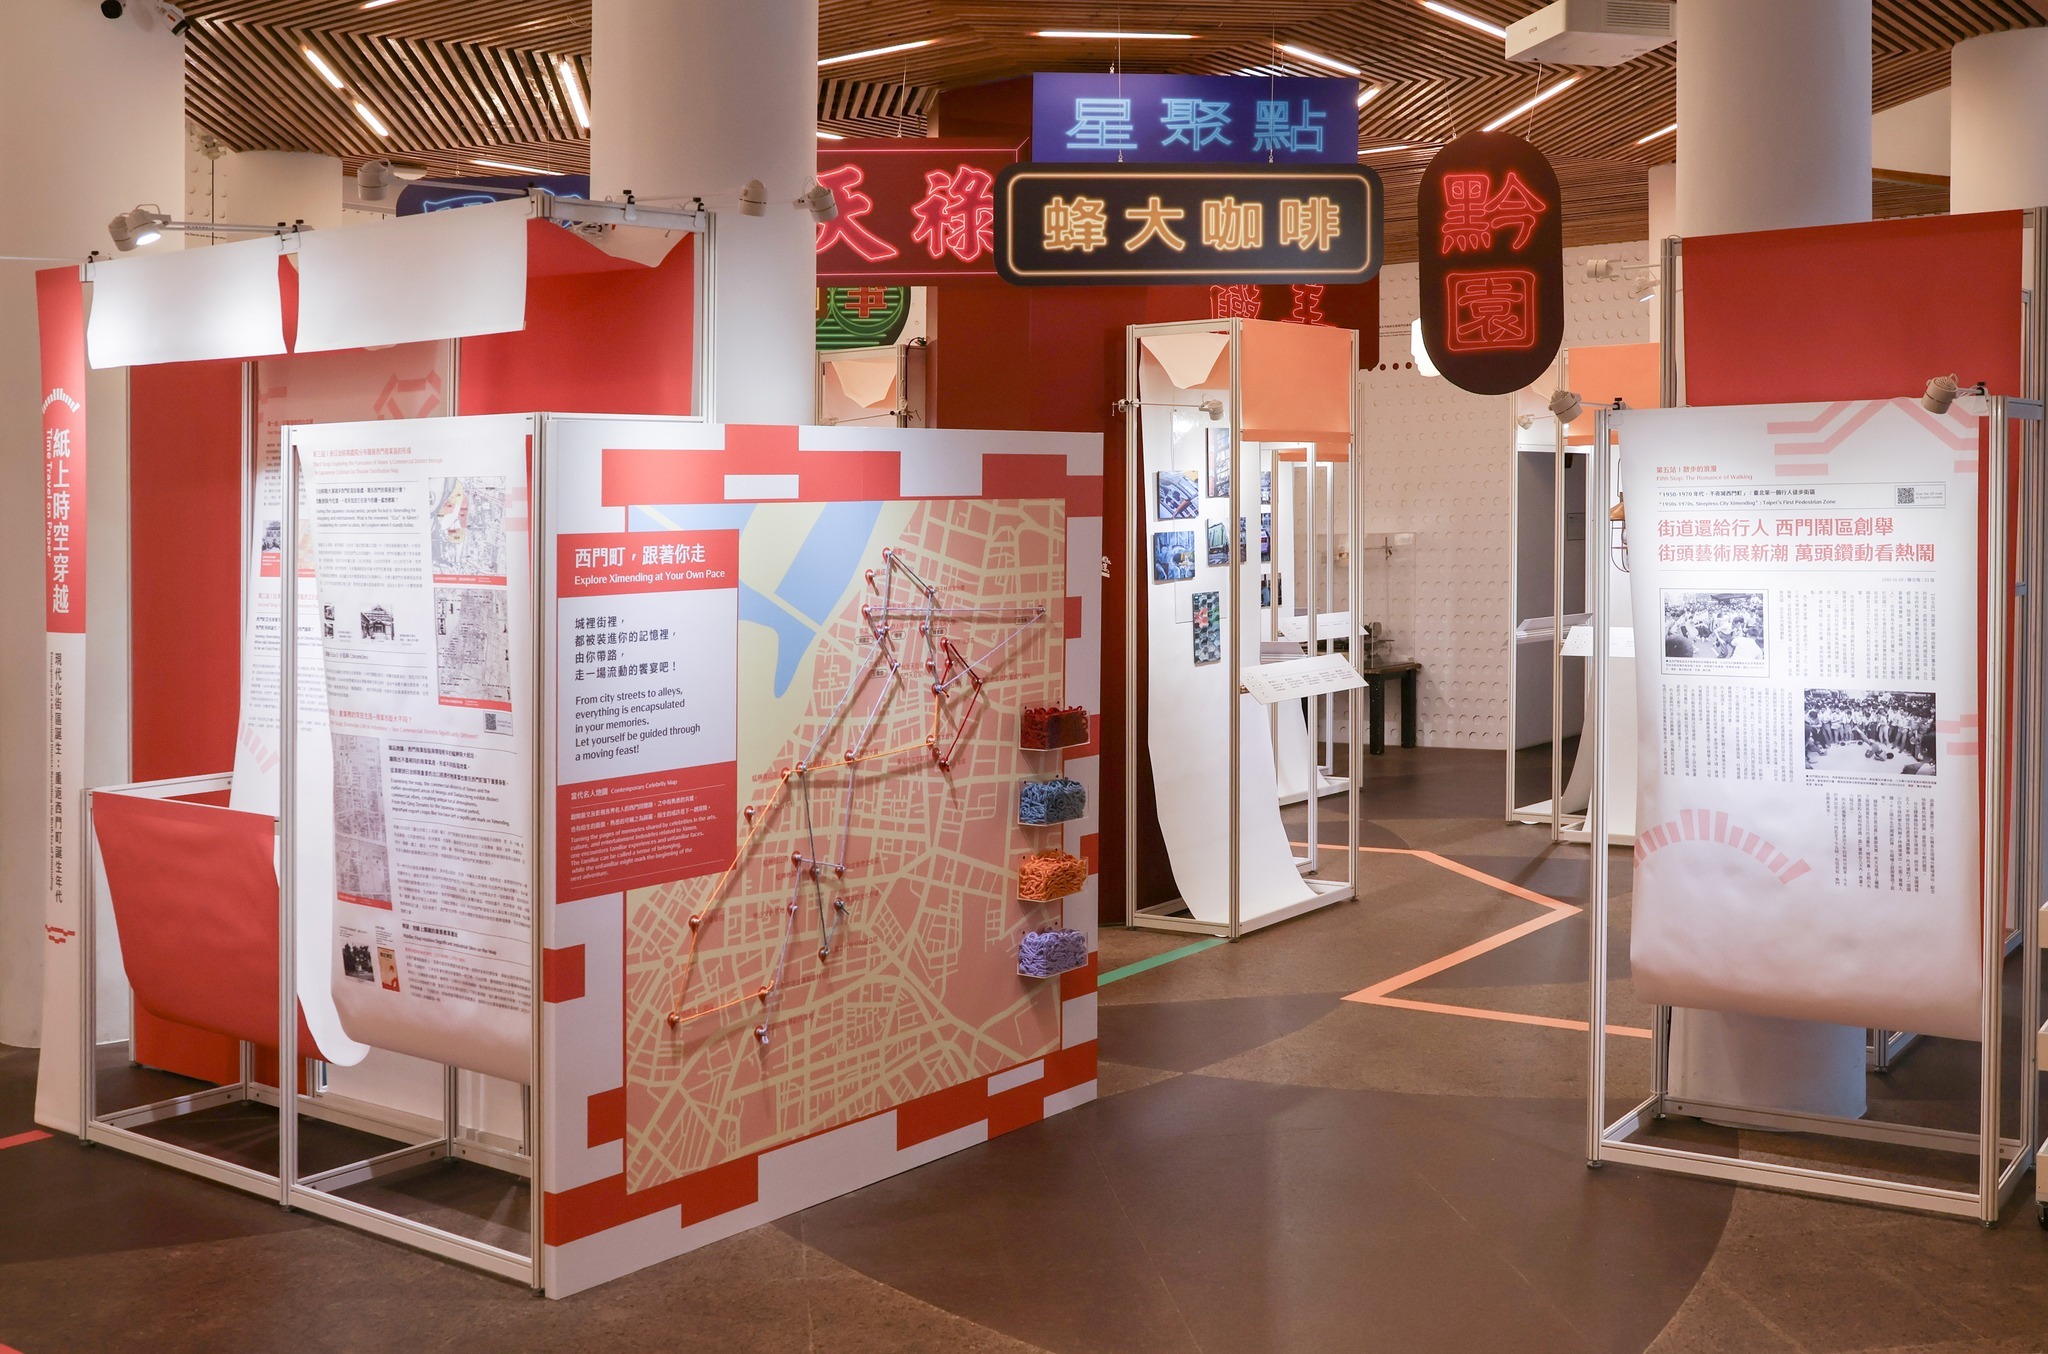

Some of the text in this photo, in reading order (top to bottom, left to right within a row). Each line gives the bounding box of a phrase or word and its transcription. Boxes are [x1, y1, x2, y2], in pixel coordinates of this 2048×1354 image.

[1065, 96, 1327, 153] 星聚點
[1042, 196, 1341, 255] 蜂大咖啡
[1440, 171, 1546, 353] 黔園
[53, 429, 70, 614] 紙上時空穿越
[1658, 517, 1894, 537] 街道還給行人 西門鬧區創舉
[575, 543, 706, 568] 西門町，跟著你走
[1658, 543, 1935, 563] 街頭藝術展新潮 萬頭鑽動看熱鬧
[575, 568, 725, 587] Explore Ximending at Your Own Pace
[576, 687, 682, 706] From city streets to alleys,
[575, 699, 685, 720] everything is encapsulated
[575, 717, 649, 735] in your memories.
[575, 723, 700, 748] Let yourself be guided through
[575, 745, 639, 762] a moving feast!
[611, 785, 645, 794] Contemporary
[645, 781, 666, 789] Celebrity
